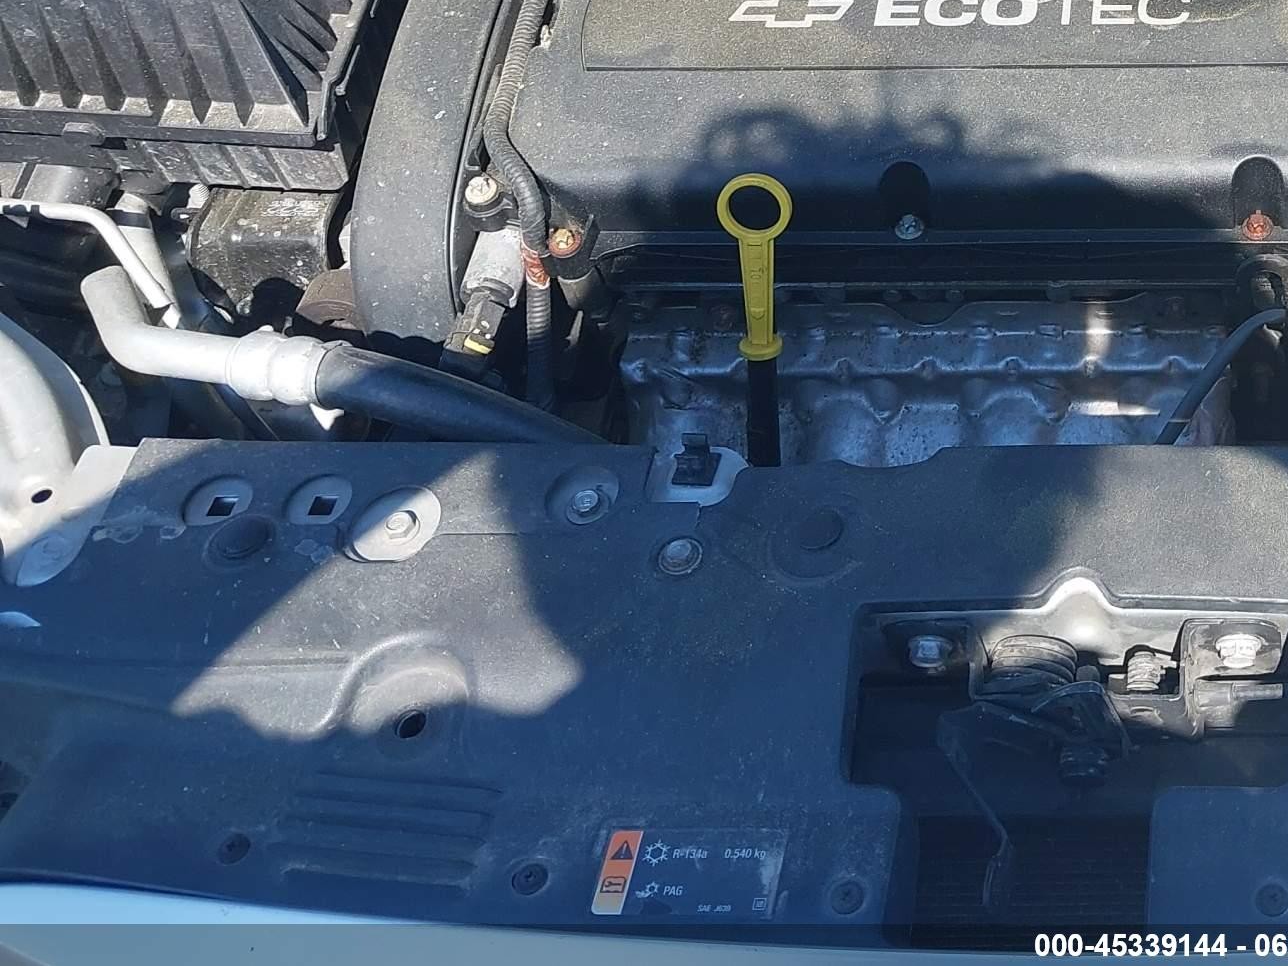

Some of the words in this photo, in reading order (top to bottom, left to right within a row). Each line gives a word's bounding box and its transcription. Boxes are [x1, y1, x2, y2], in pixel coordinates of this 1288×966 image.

[673, 847, 708, 859] R-134a
[724, 847, 752, 859] 0.540
[753, 847, 766, 861] kg
[663, 885, 683, 896] PAG
